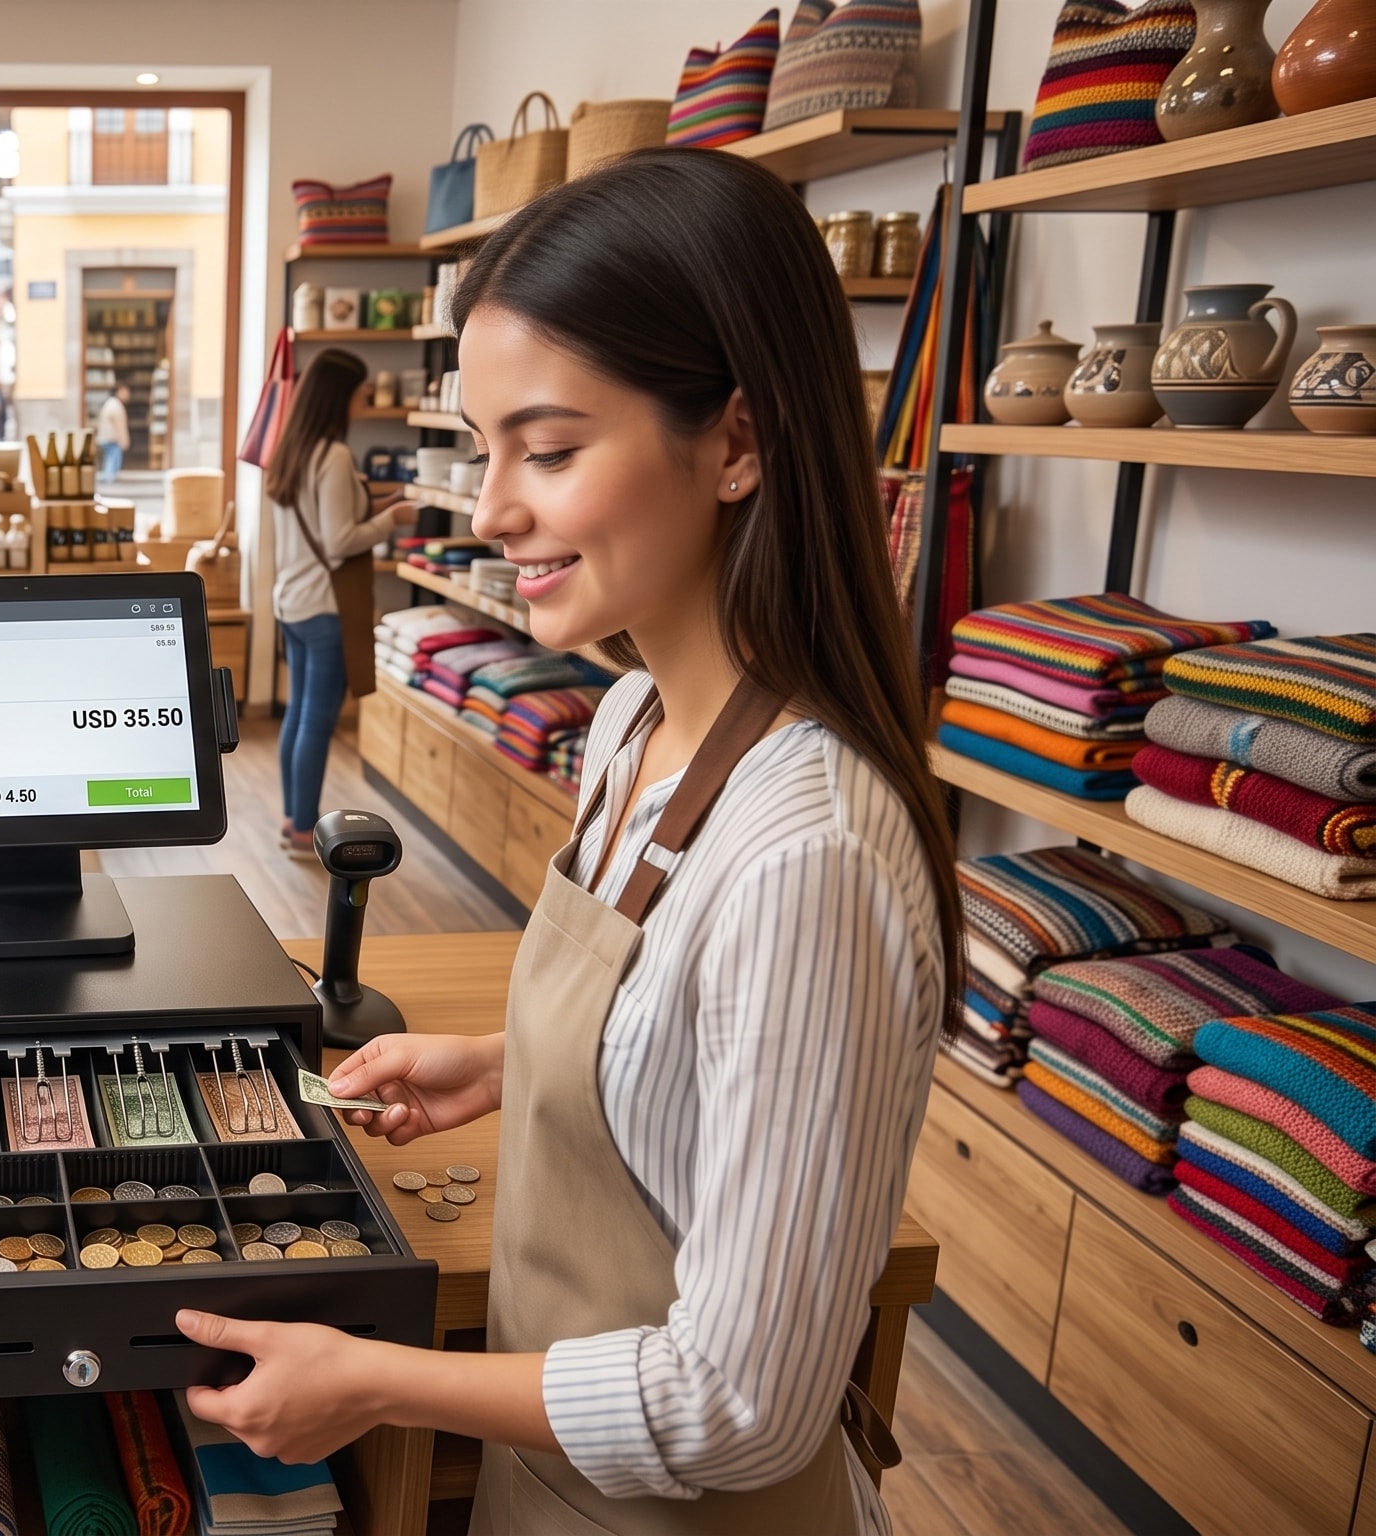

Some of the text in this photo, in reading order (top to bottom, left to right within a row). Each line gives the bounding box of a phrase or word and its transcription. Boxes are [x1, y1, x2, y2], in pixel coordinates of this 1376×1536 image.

[72, 707, 184, 729] USD 35.50
[5, 788, 37, 803] 4.50
[124, 786, 153, 798] Total
